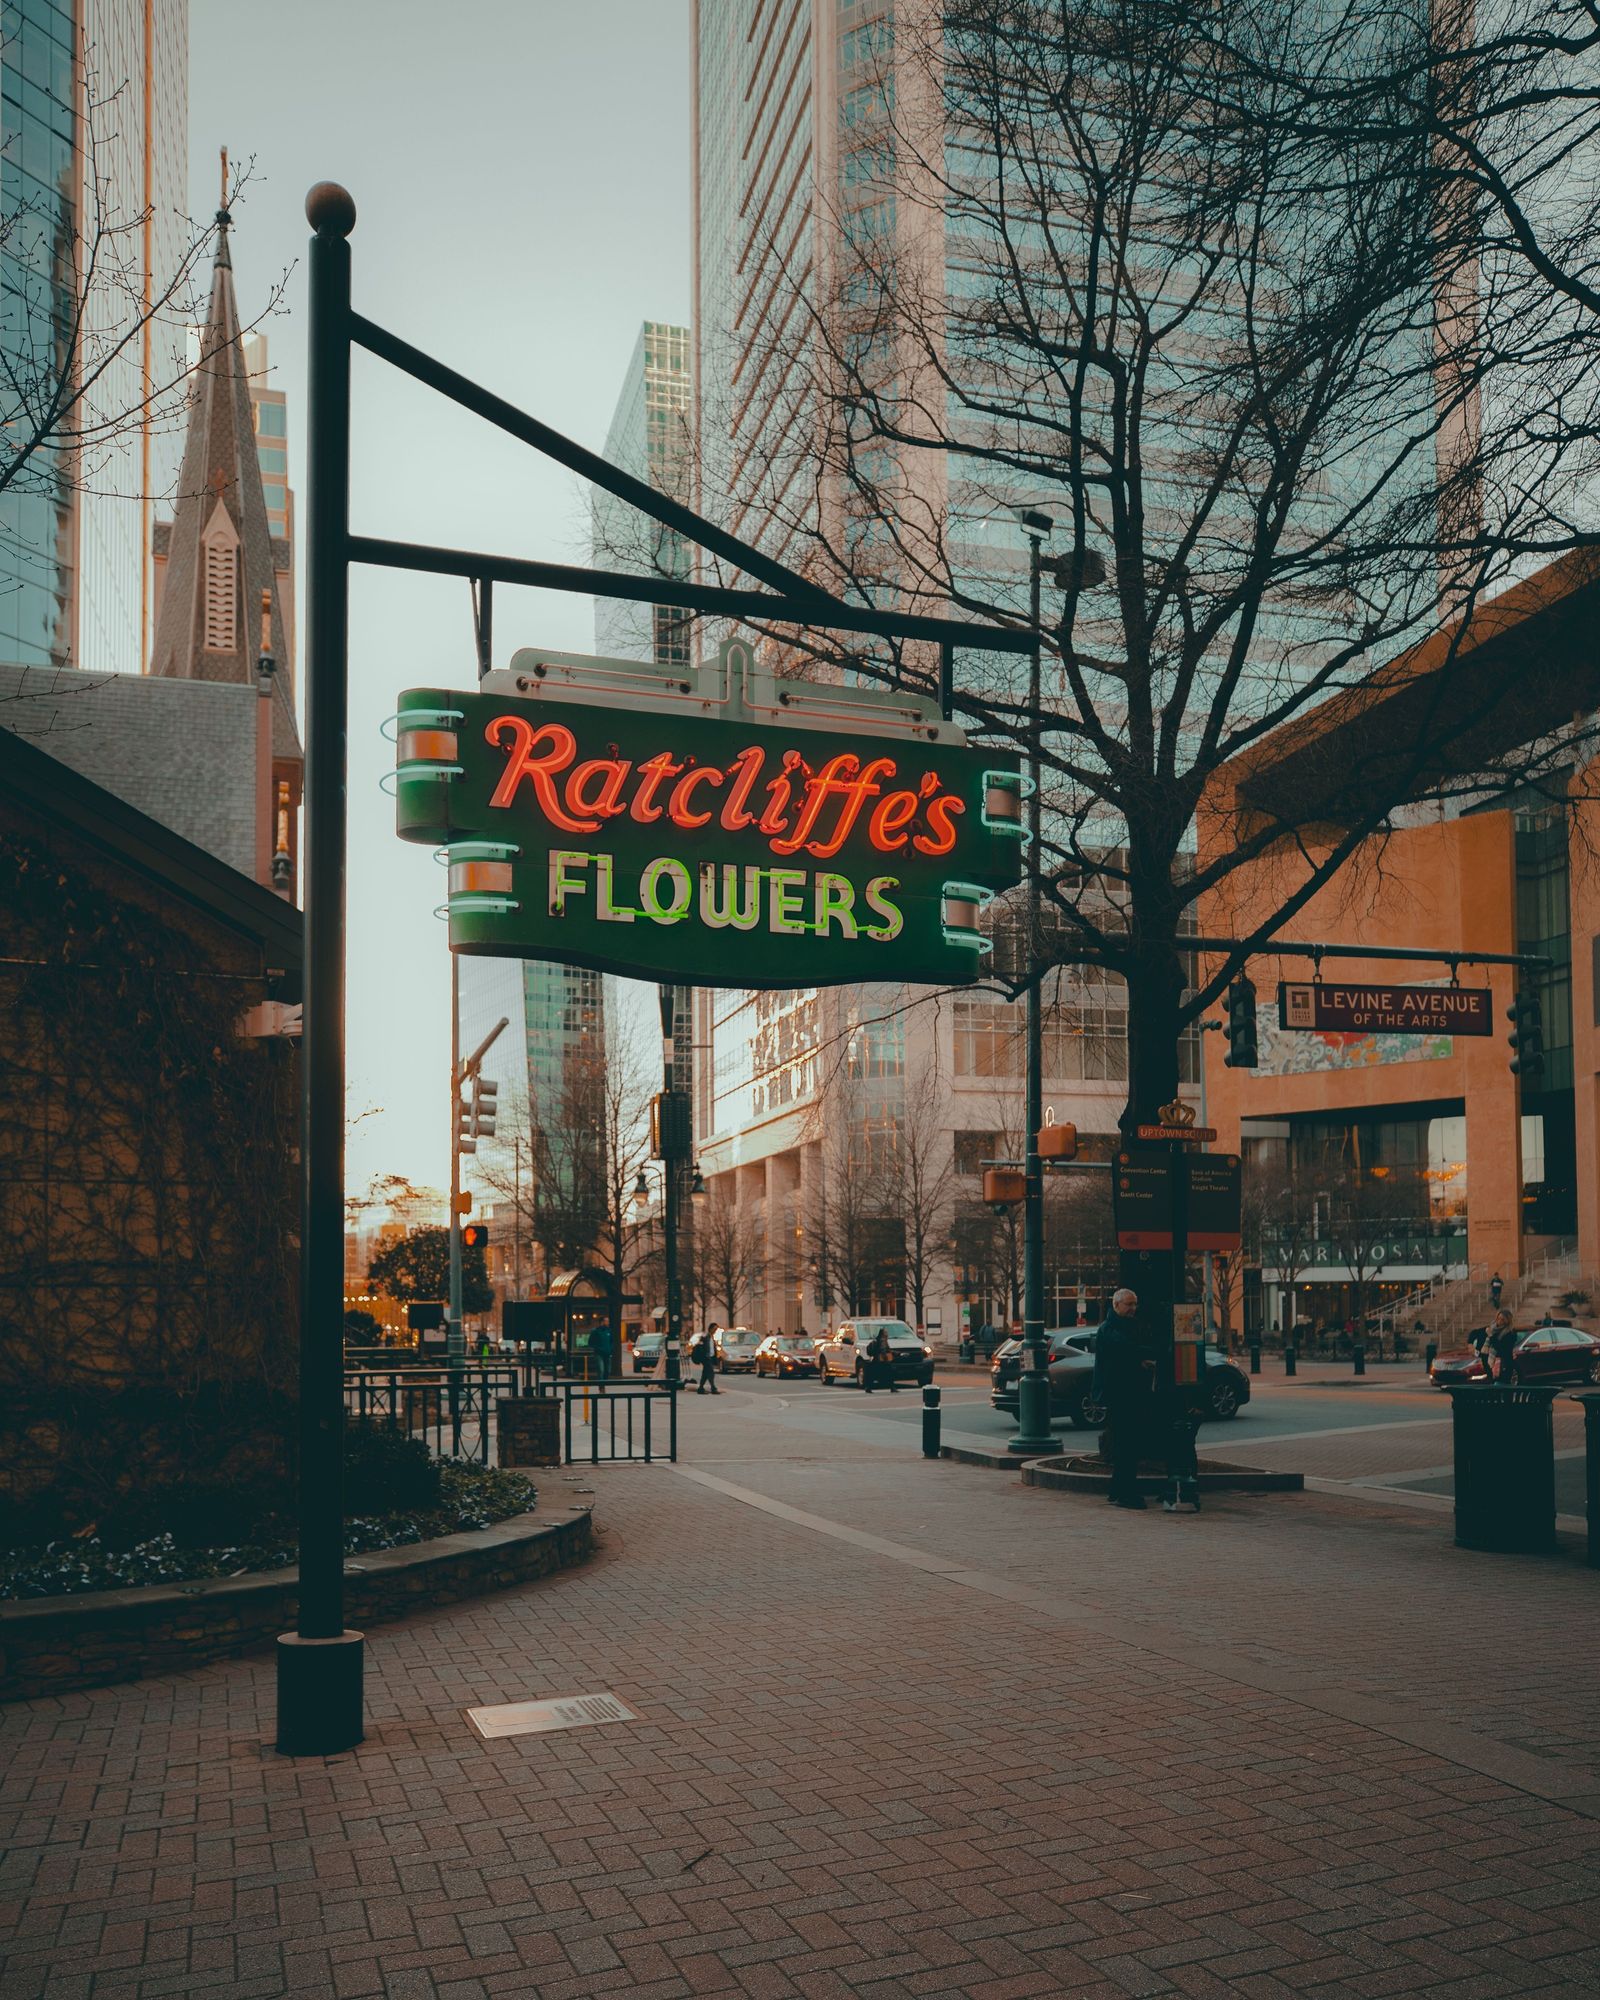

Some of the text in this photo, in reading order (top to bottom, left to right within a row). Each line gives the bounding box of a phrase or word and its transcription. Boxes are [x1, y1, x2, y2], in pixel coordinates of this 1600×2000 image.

[485, 715, 966, 858] Ratcliffe's
[548, 849, 904, 942] FLOWERS
[1321, 991, 1480, 1013] LEVINE AVENUE
[1353, 1013, 1448, 1028] OF THE ARTS
[1140, 1128, 1216, 1140] UPTOWN SOUTH
[1279, 1244, 1423, 1262] MARIPOSA
